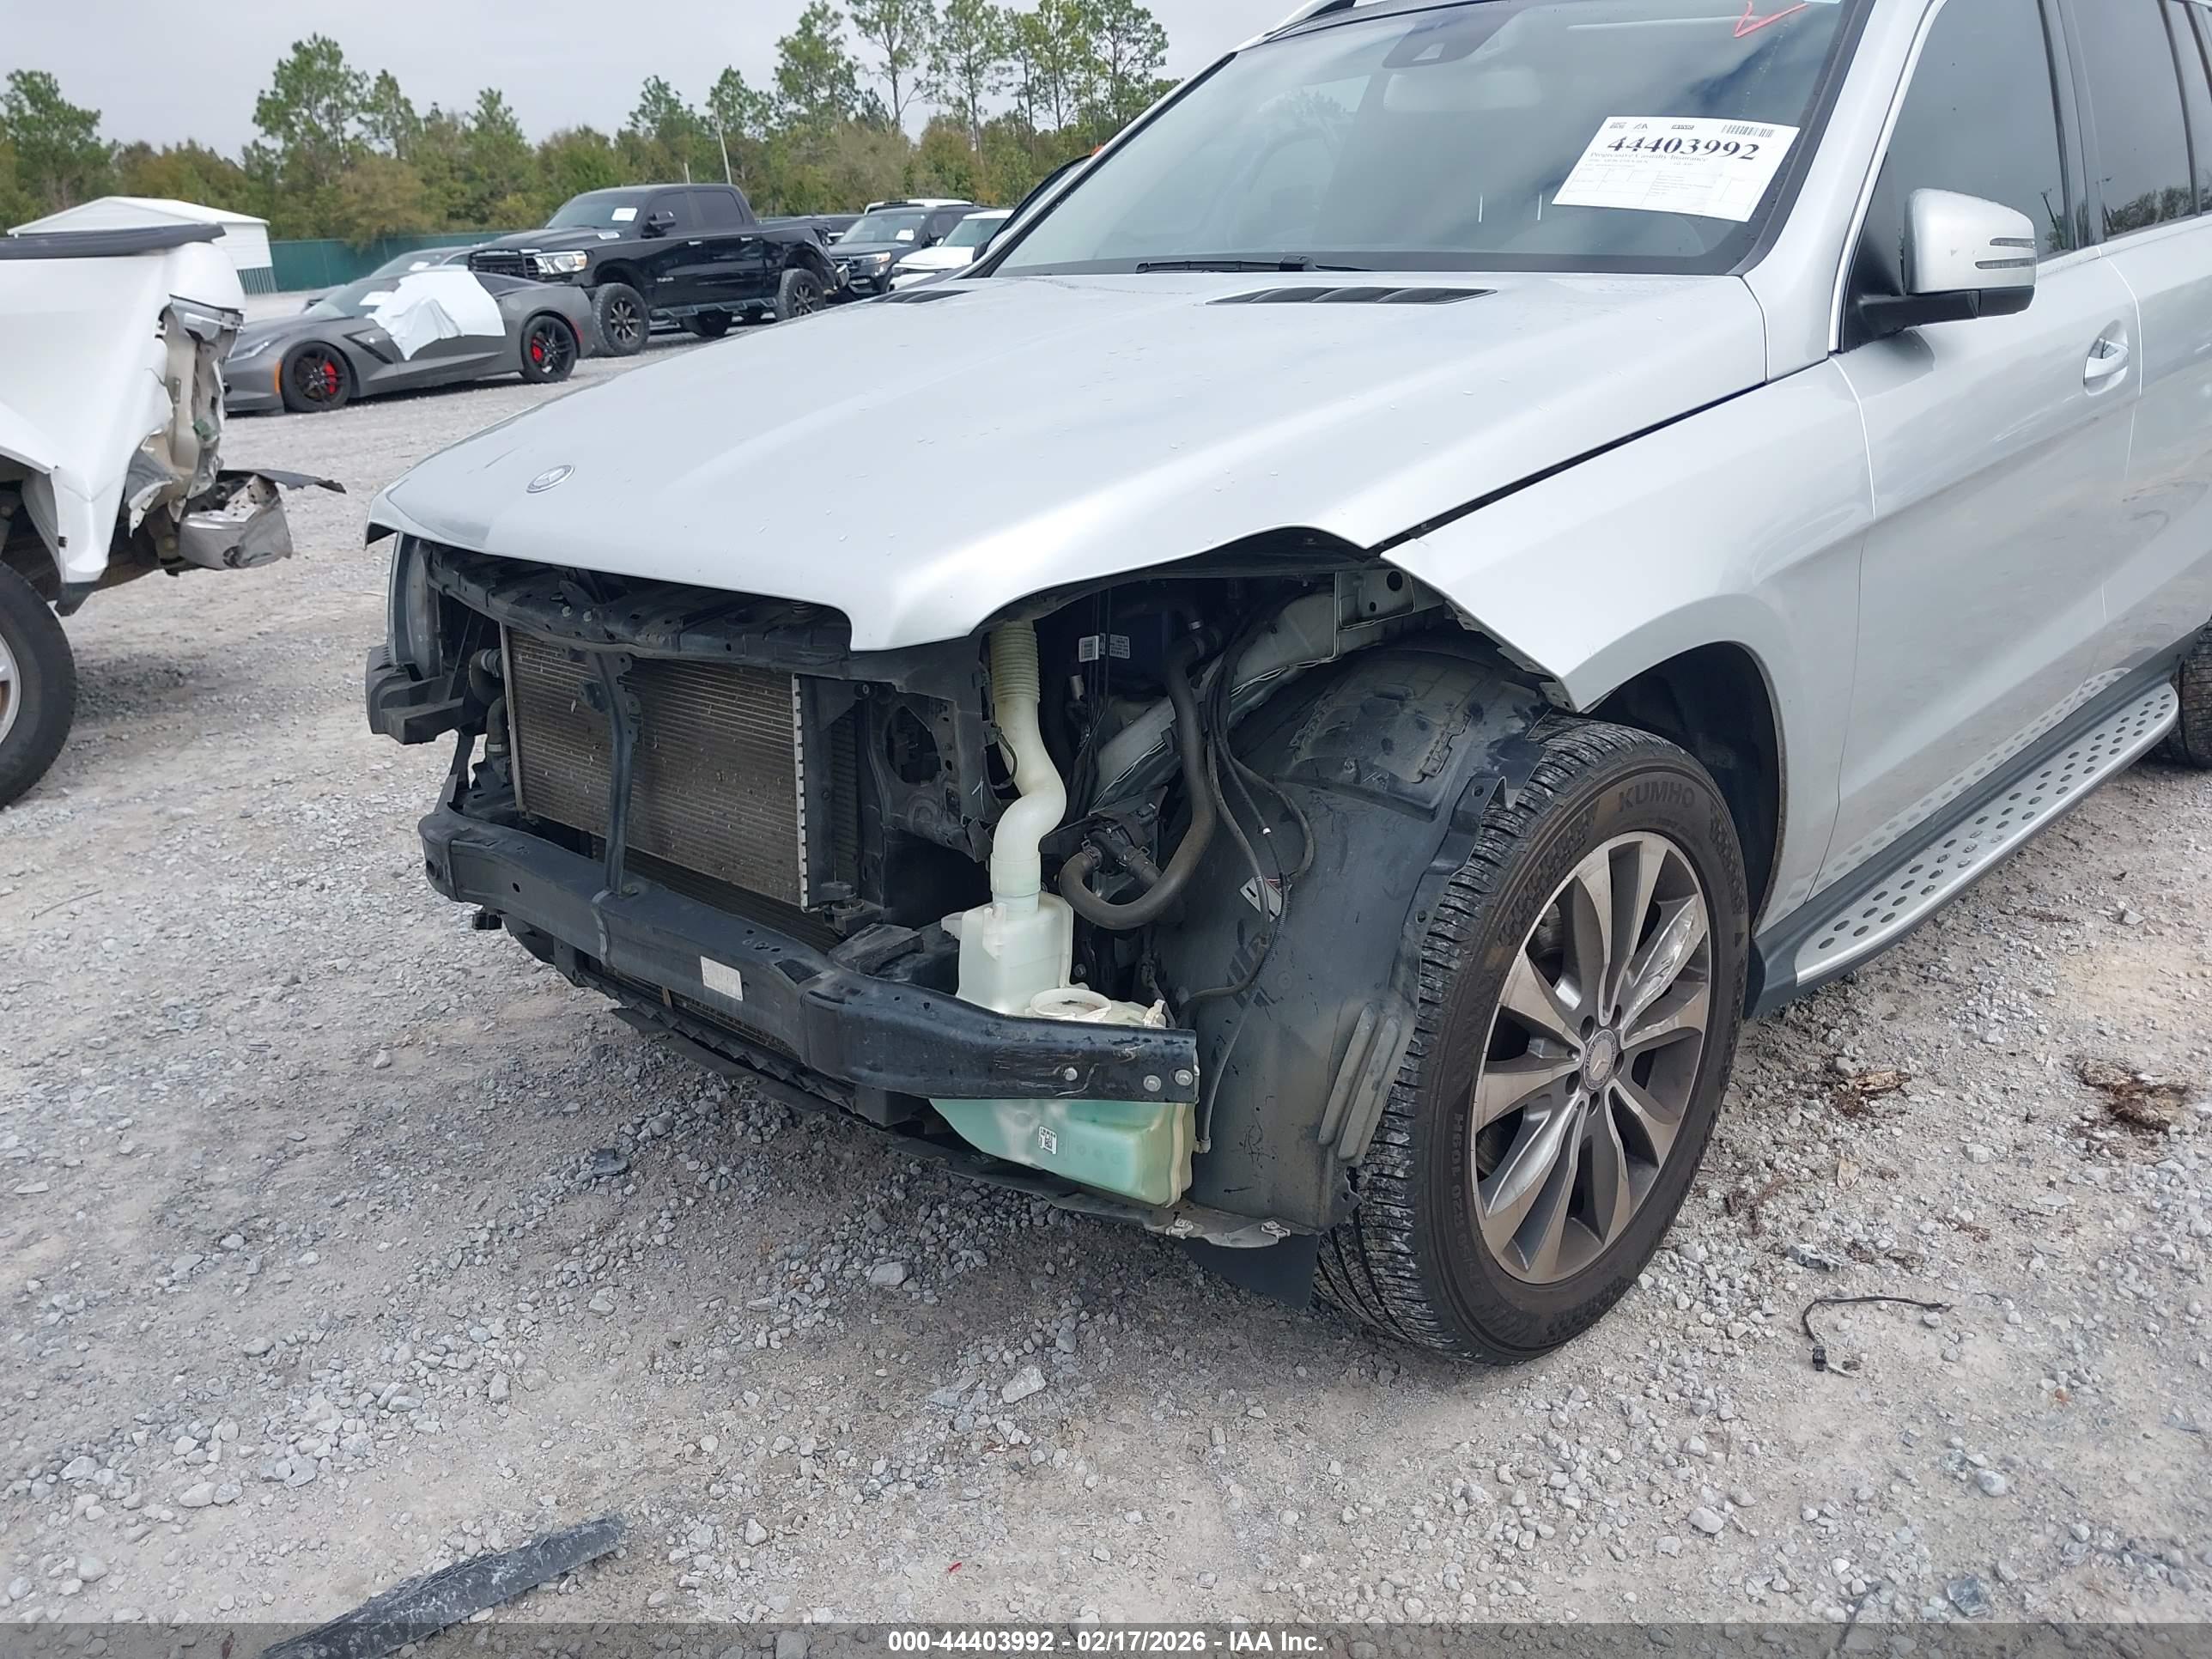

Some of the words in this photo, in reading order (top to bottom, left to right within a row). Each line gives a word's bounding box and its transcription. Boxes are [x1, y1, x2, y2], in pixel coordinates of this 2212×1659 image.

[1607, 136, 1760, 161] 44403992
[1619, 781, 1695, 812] KUMHO
[1451, 1114, 1464, 1176] 109H
